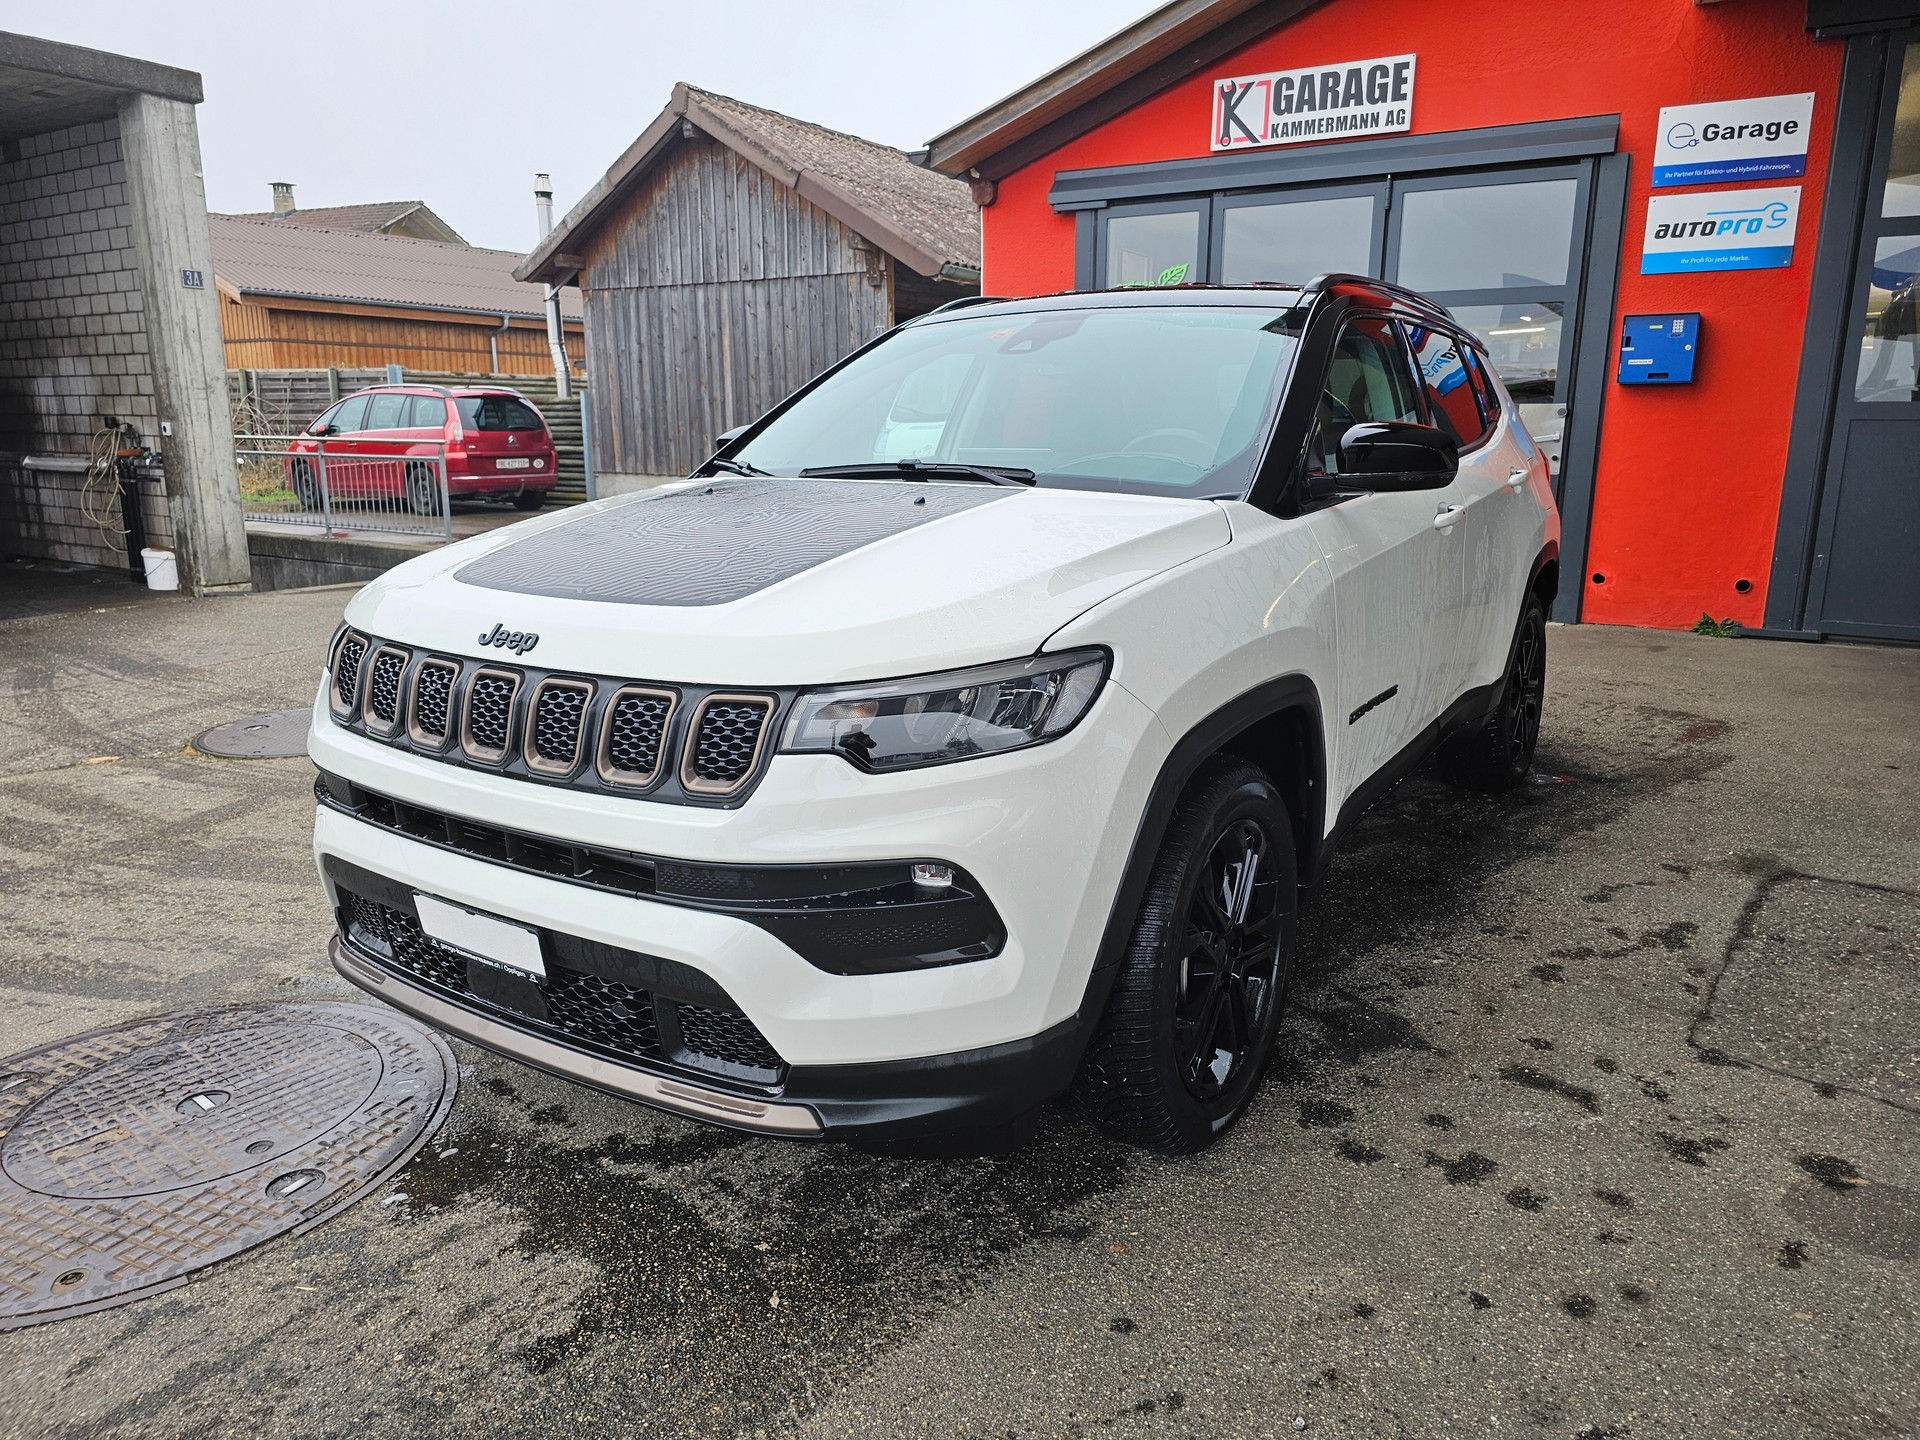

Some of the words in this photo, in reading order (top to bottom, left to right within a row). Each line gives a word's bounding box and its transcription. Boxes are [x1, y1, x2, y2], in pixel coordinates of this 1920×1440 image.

[1272, 61, 1410, 116] GARAGE
[1270, 112, 1380, 139] KAMMERMANN
[1385, 109, 1406, 127] AG
[1702, 120, 1798, 142] Garage
[1726, 166, 1738, 174] und
[1714, 255, 1728, 264] jede
[1729, 254, 1750, 262] Marke.
[186, 271, 201, 286] 3A
[478, 622, 539, 656] Jeep
